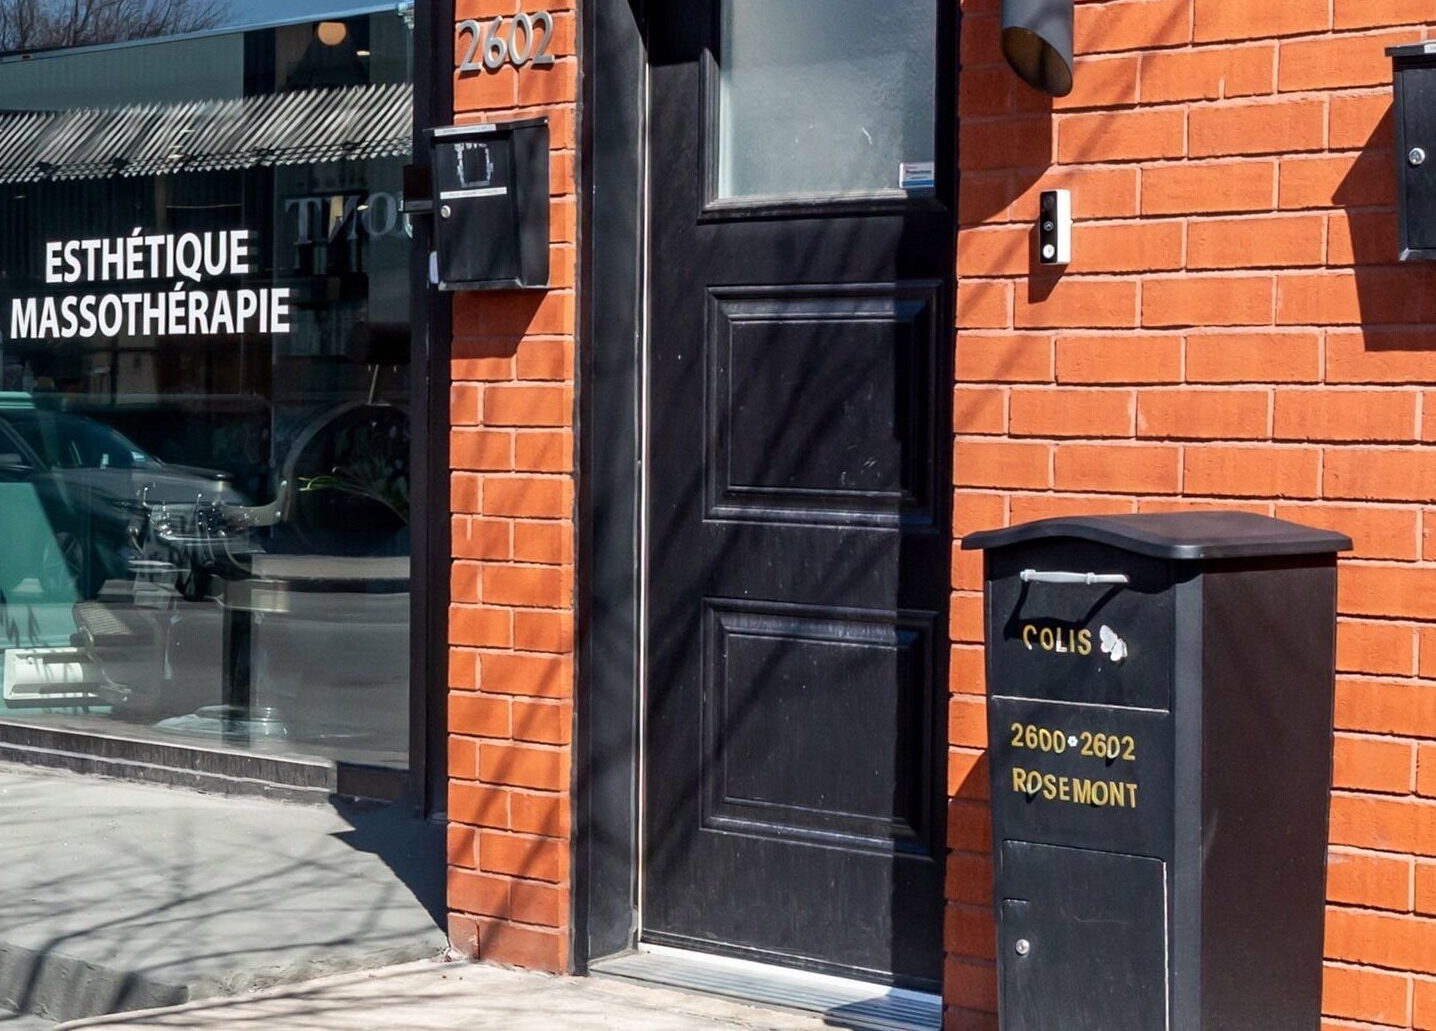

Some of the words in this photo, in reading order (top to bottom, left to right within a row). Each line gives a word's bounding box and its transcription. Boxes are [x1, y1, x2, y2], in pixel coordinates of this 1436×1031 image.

[458, 11, 555, 71] 2602
[46, 227, 250, 282] ESTHÉTIQUE
[11, 282, 291, 340] MASSOTHÉRAPIE
[1023, 624, 1092, 655] COLIS
[1012, 767, 1138, 809] ROSEMONT
